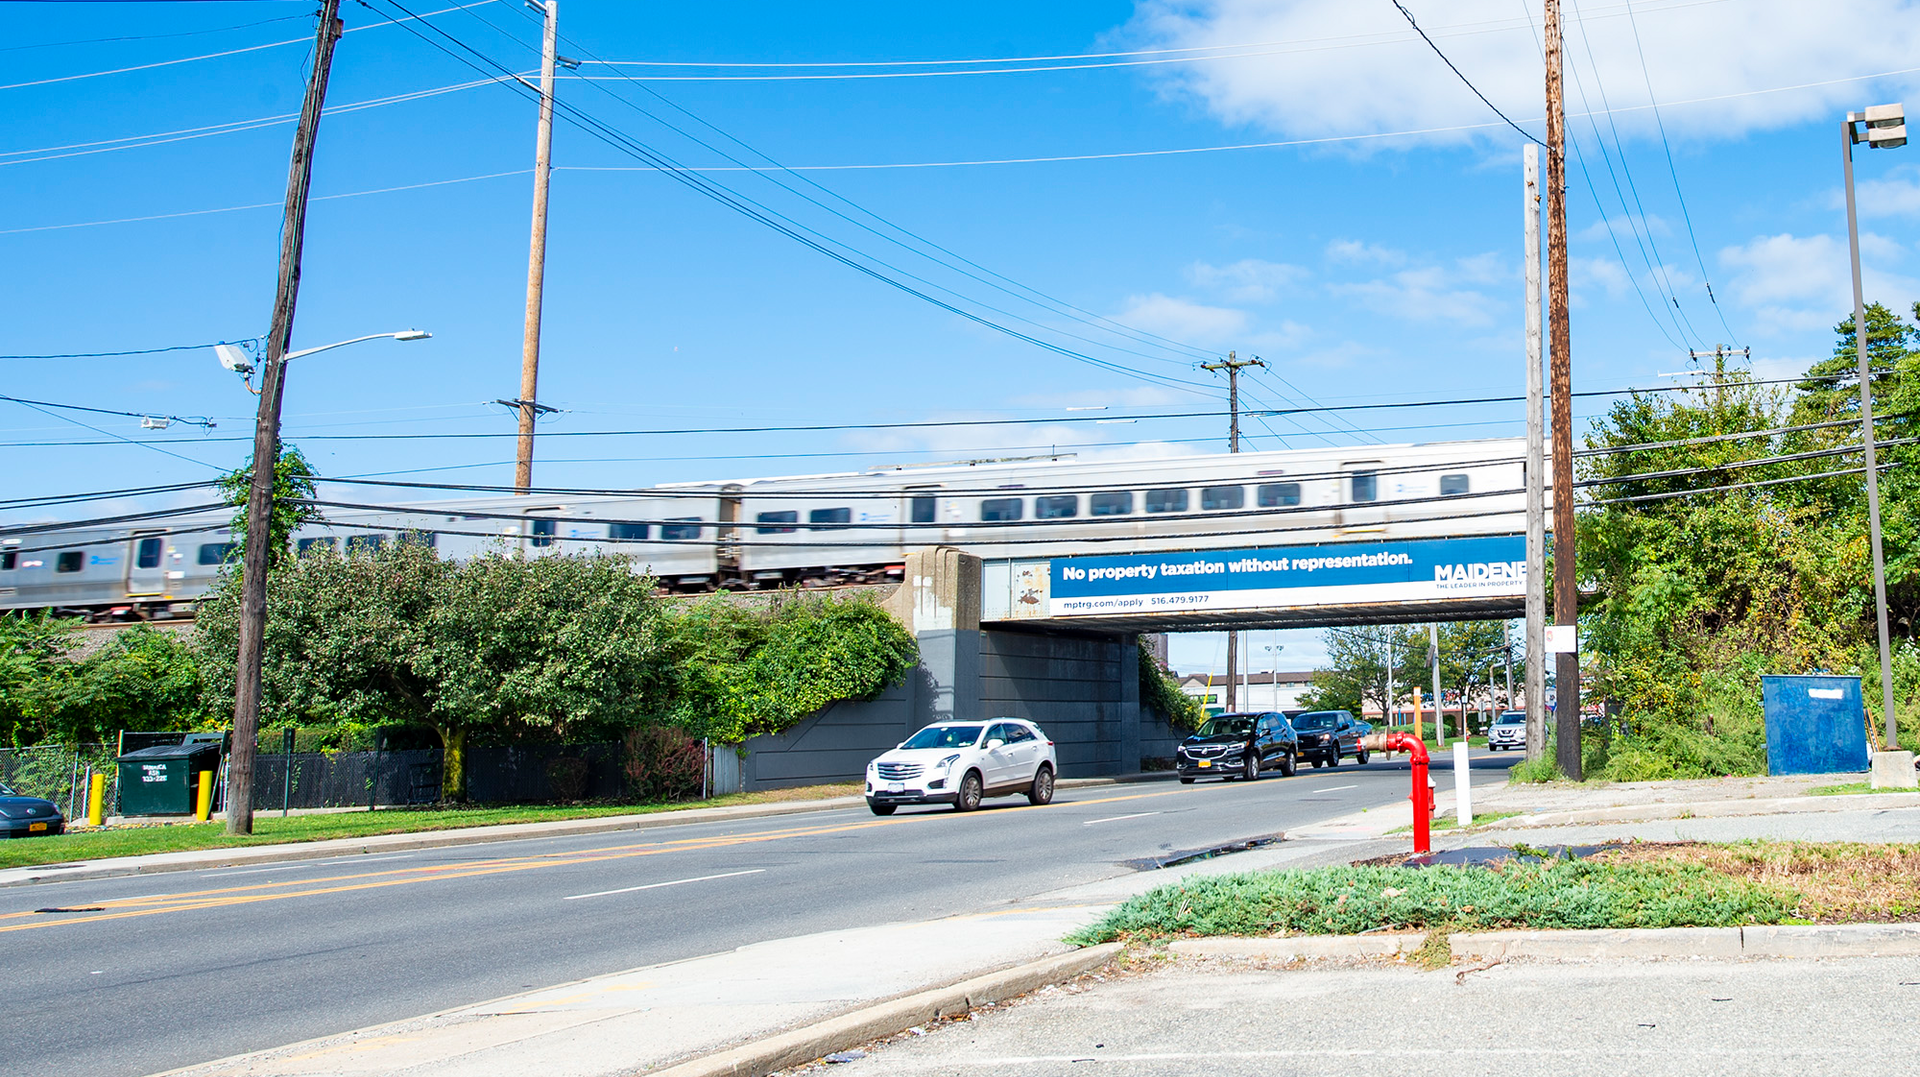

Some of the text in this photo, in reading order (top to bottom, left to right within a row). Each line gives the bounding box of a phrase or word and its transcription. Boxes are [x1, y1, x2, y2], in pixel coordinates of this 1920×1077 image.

[1062, 551, 1413, 582] No property taxation without representation.
[1063, 595, 1210, 610] mptrg.com/apply 516.479.9177
